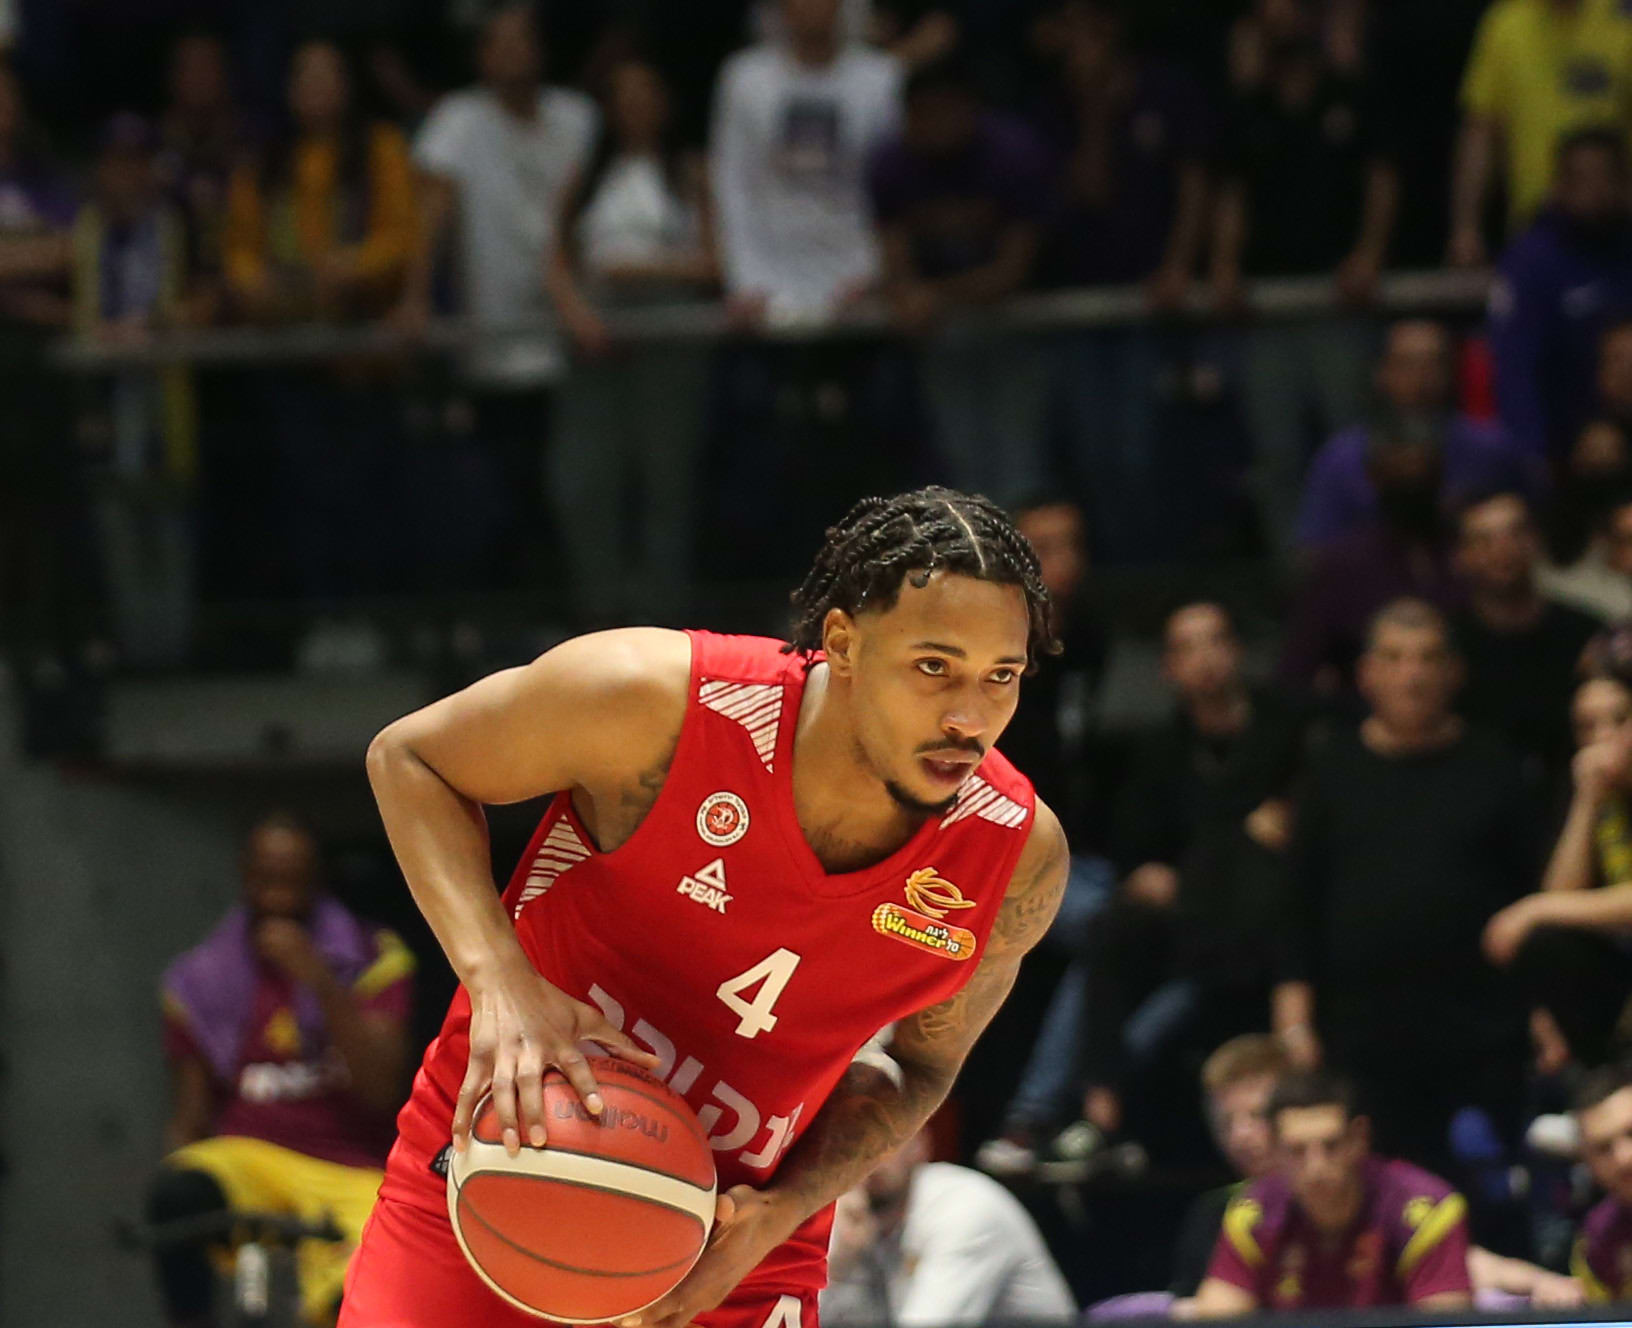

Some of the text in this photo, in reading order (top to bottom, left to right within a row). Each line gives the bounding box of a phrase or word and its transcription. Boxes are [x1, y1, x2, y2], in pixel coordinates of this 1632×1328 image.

[676, 875, 734, 914] PEAK
[885, 912, 946, 948] Winner
[716, 947, 801, 1040] 4
